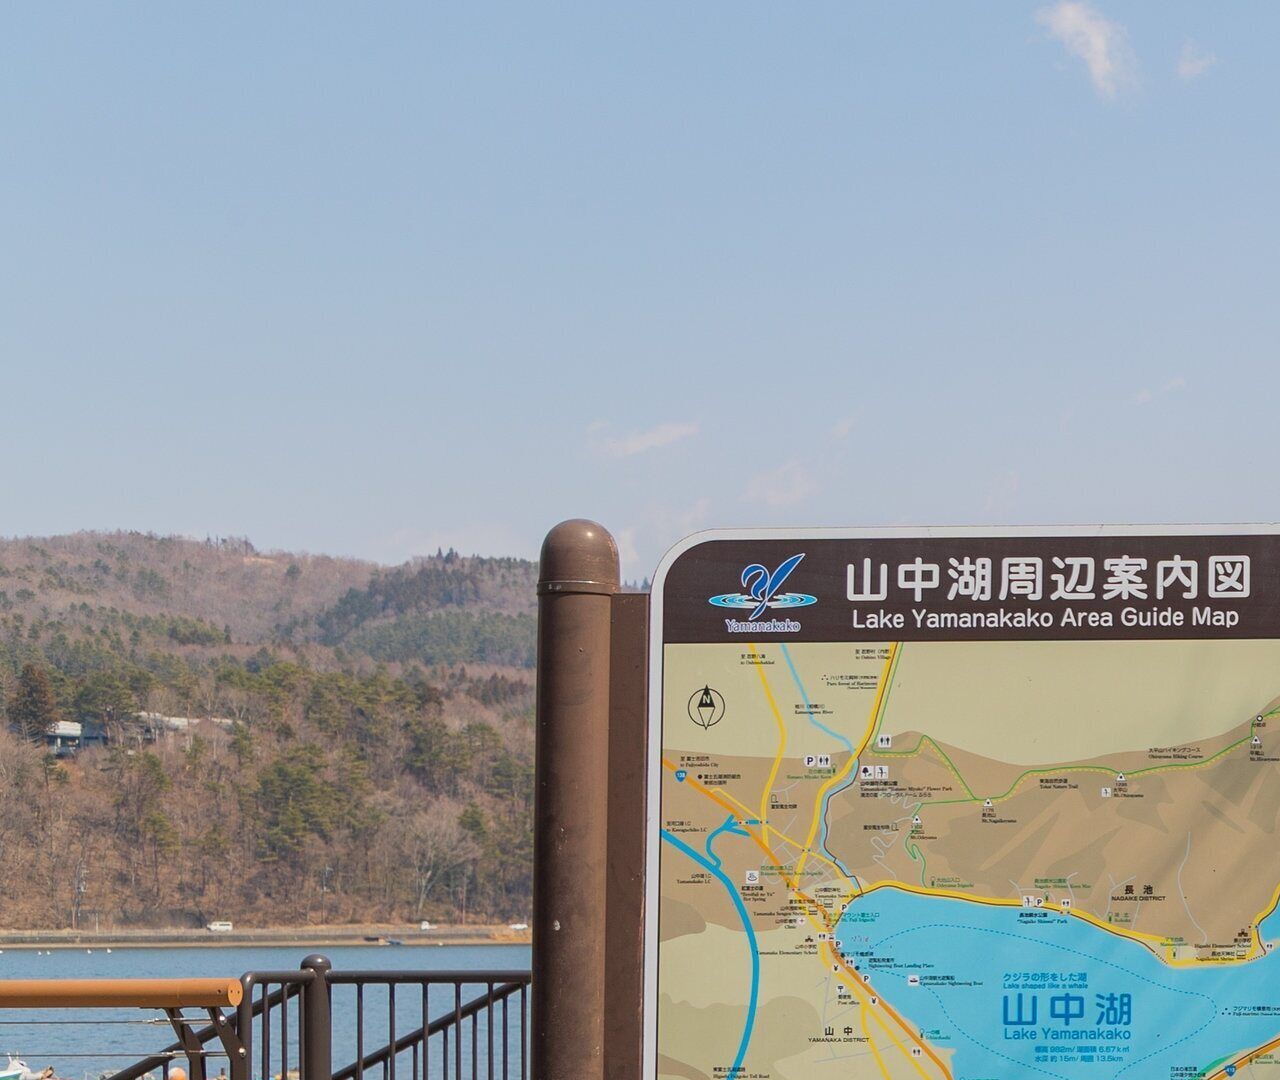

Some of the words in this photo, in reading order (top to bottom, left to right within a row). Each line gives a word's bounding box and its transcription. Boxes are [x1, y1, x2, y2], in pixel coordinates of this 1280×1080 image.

[847, 555, 1250, 602] 山中湖周辺案内図
[852, 609, 905, 629] Lake
[911, 607, 1053, 629] Yamanakako
[1061, 607, 1113, 627] Area
[1120, 606, 1184, 627] Guide
[1192, 606, 1240, 628] Map
[725, 618, 801, 633] Yamanakako
[702, 694, 711, 703] N
[1003, 972, 1087, 982] クジラの形をした湖
[1021, 982, 1046, 991] shaped
[1003, 992, 1132, 1026] 山中湖
[1004, 1028, 1037, 1040] Lake
[1041, 1028, 1132, 1041] Yamanakako
